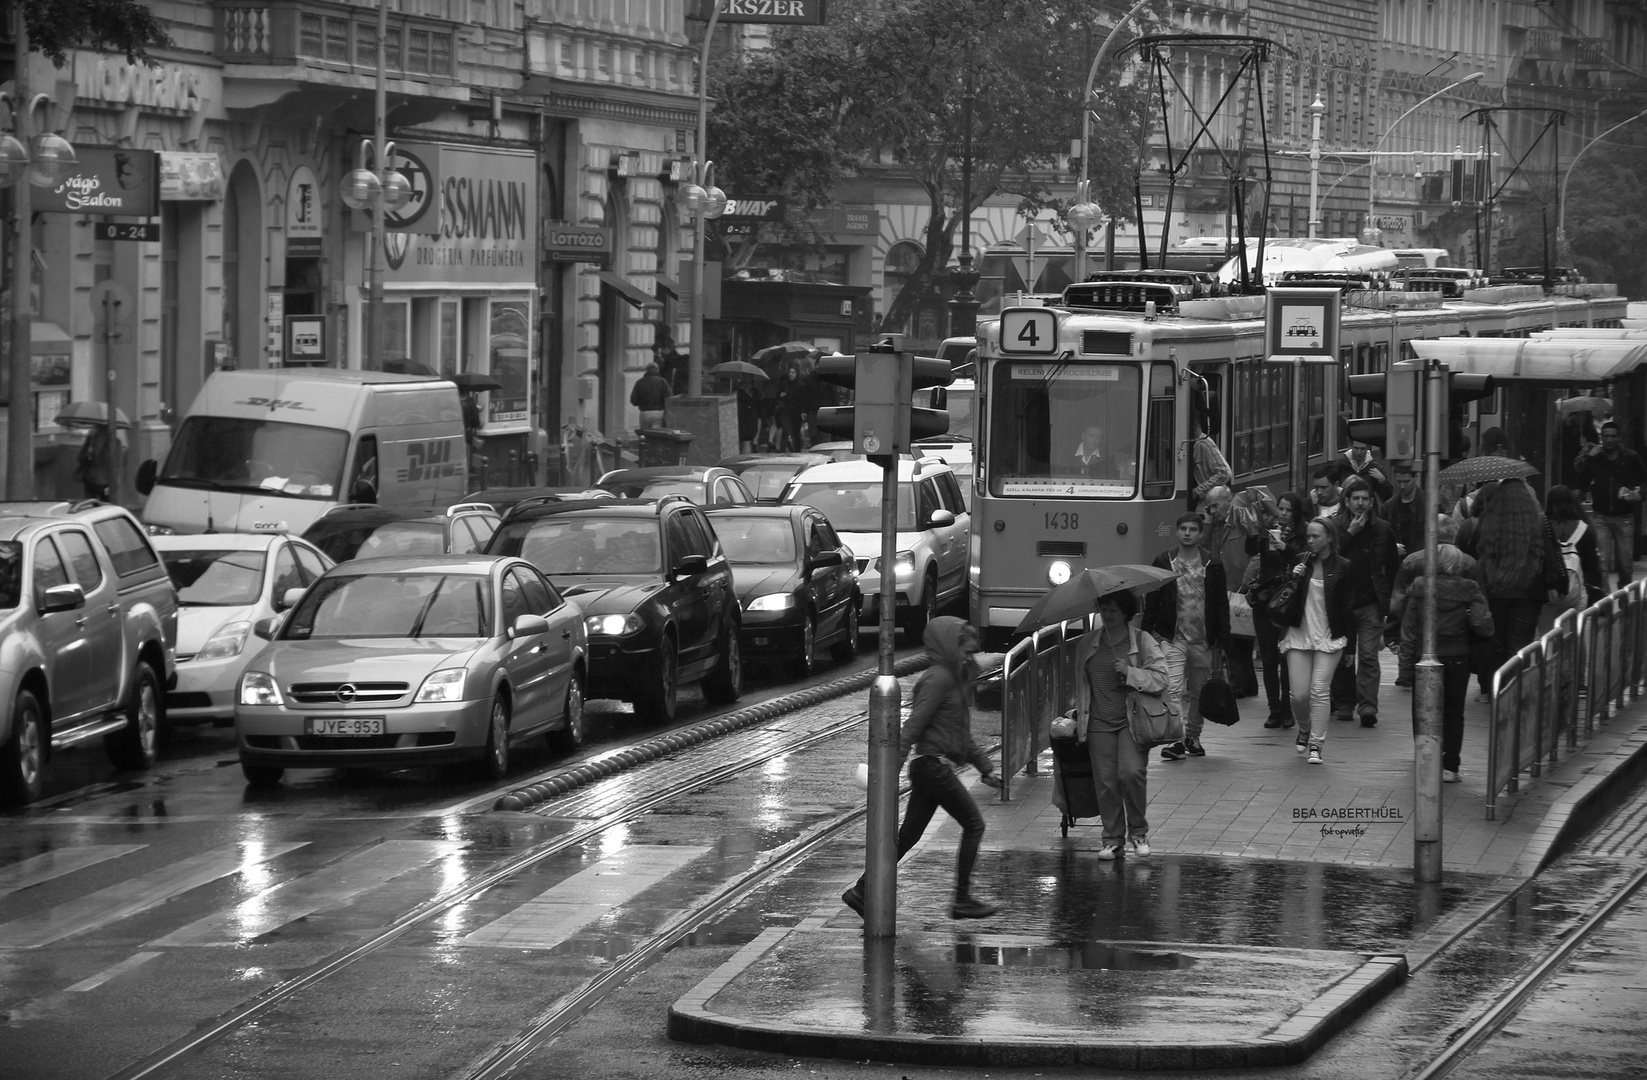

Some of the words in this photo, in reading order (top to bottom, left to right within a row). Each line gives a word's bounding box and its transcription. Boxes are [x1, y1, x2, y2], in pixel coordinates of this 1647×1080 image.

[65, 191, 122, 209] Szalon
[722, 200, 778, 215] BWAY
[846, 214, 869, 222] TRAVEL
[107, 225, 117, 237] 0
[129, 227, 146, 239] 24
[740, 225, 750, 233] 24
[846, 222, 869, 230] AGENCY
[1018, 319, 1040, 347] 4
[1018, 368, 1062, 376] KELENFD
[248, 396, 304, 410] DHL
[406, 439, 455, 482] DHL
[1066, 486, 1075, 494] 4
[1044, 512, 1079, 530] 1438
[316, 720, 380, 734] JYE-953
